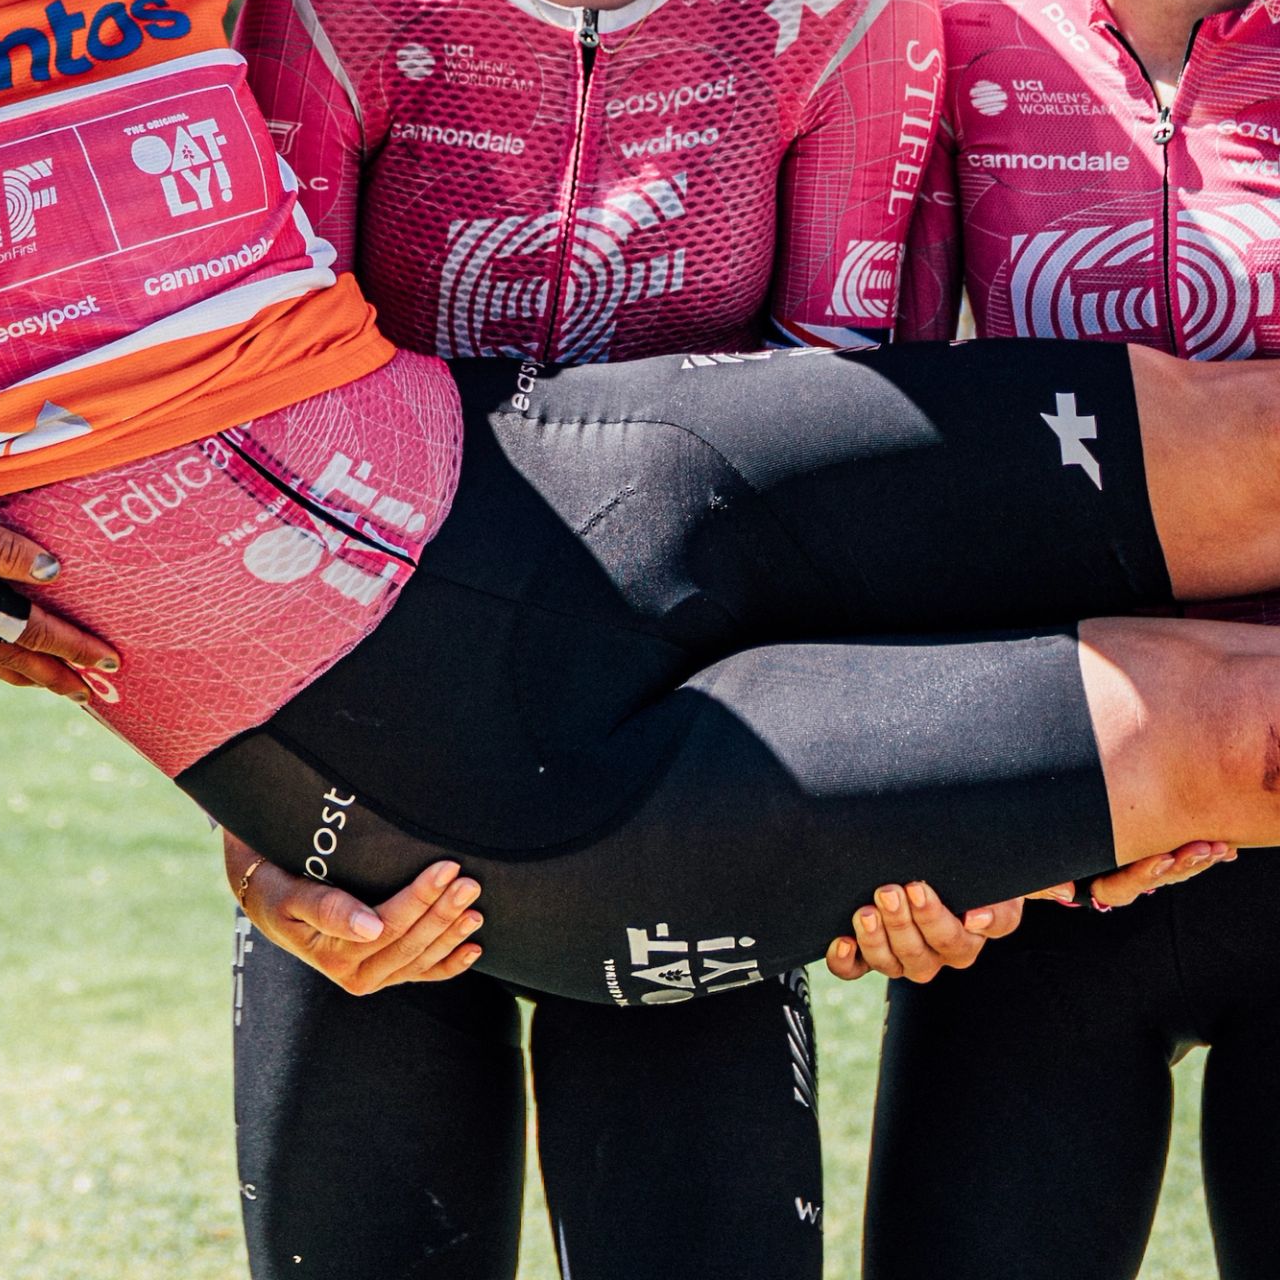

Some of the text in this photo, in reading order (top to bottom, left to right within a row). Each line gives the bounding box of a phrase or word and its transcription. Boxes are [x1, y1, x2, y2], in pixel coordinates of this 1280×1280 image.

[1040, 2, 1091, 54] poc
[443, 44, 475, 58] UCI
[605, 74, 738, 120] easypost
[1012, 80, 1044, 91] UCI
[1016, 92, 1091, 104] WOMEN'S
[390, 123, 526, 155] cannondale
[621, 126, 719, 159] wahoo
[885, 38, 943, 217] STIFEL
[967, 151, 1131, 171] cannondale
[303, 787, 356, 886] post
